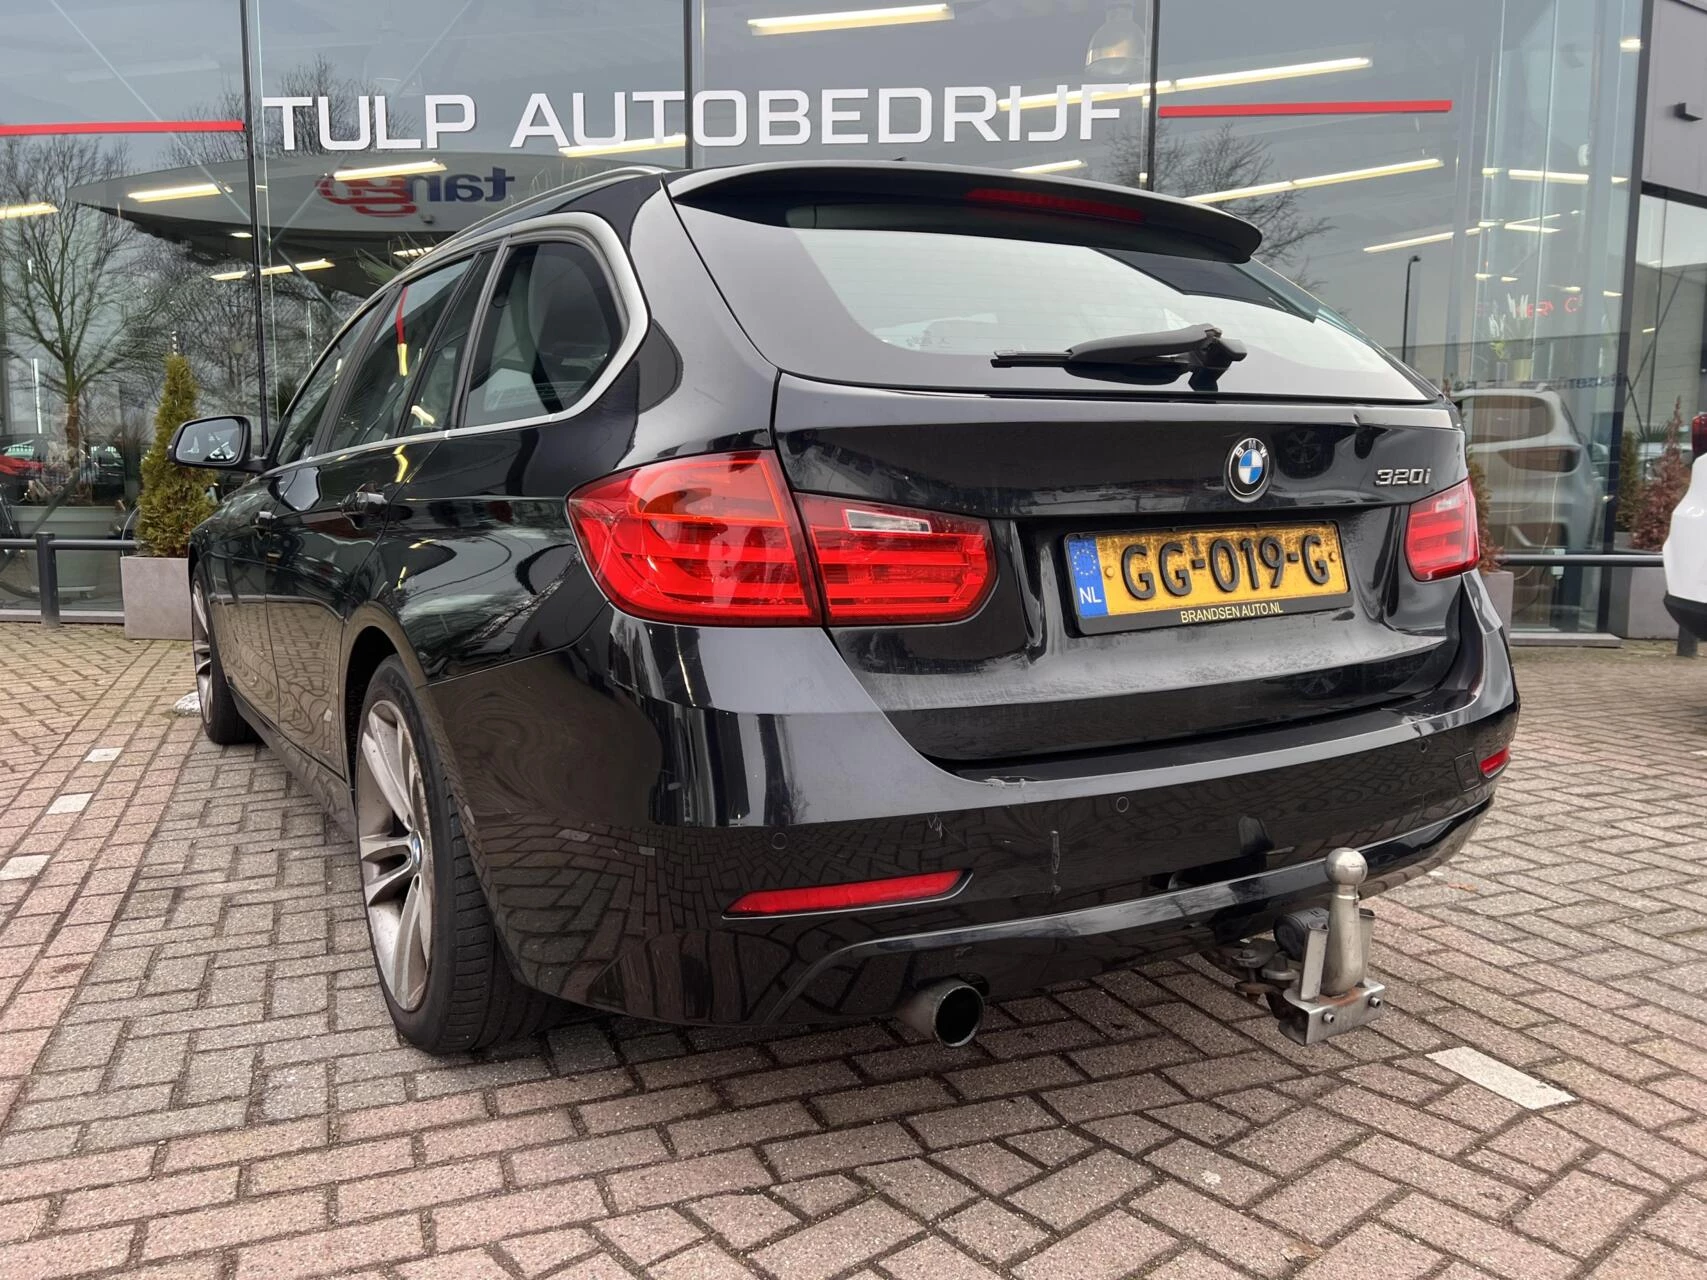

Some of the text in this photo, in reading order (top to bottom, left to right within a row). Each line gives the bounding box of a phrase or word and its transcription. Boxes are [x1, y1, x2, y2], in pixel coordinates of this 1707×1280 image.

[262, 83, 1130, 151] TULP AUTOBEDRIJF
[1235, 439, 1268, 457] BMW
[1375, 467, 1432, 486] 320i
[1121, 533, 1330, 601] GG-019-G
[1079, 586, 1103, 605] NL
